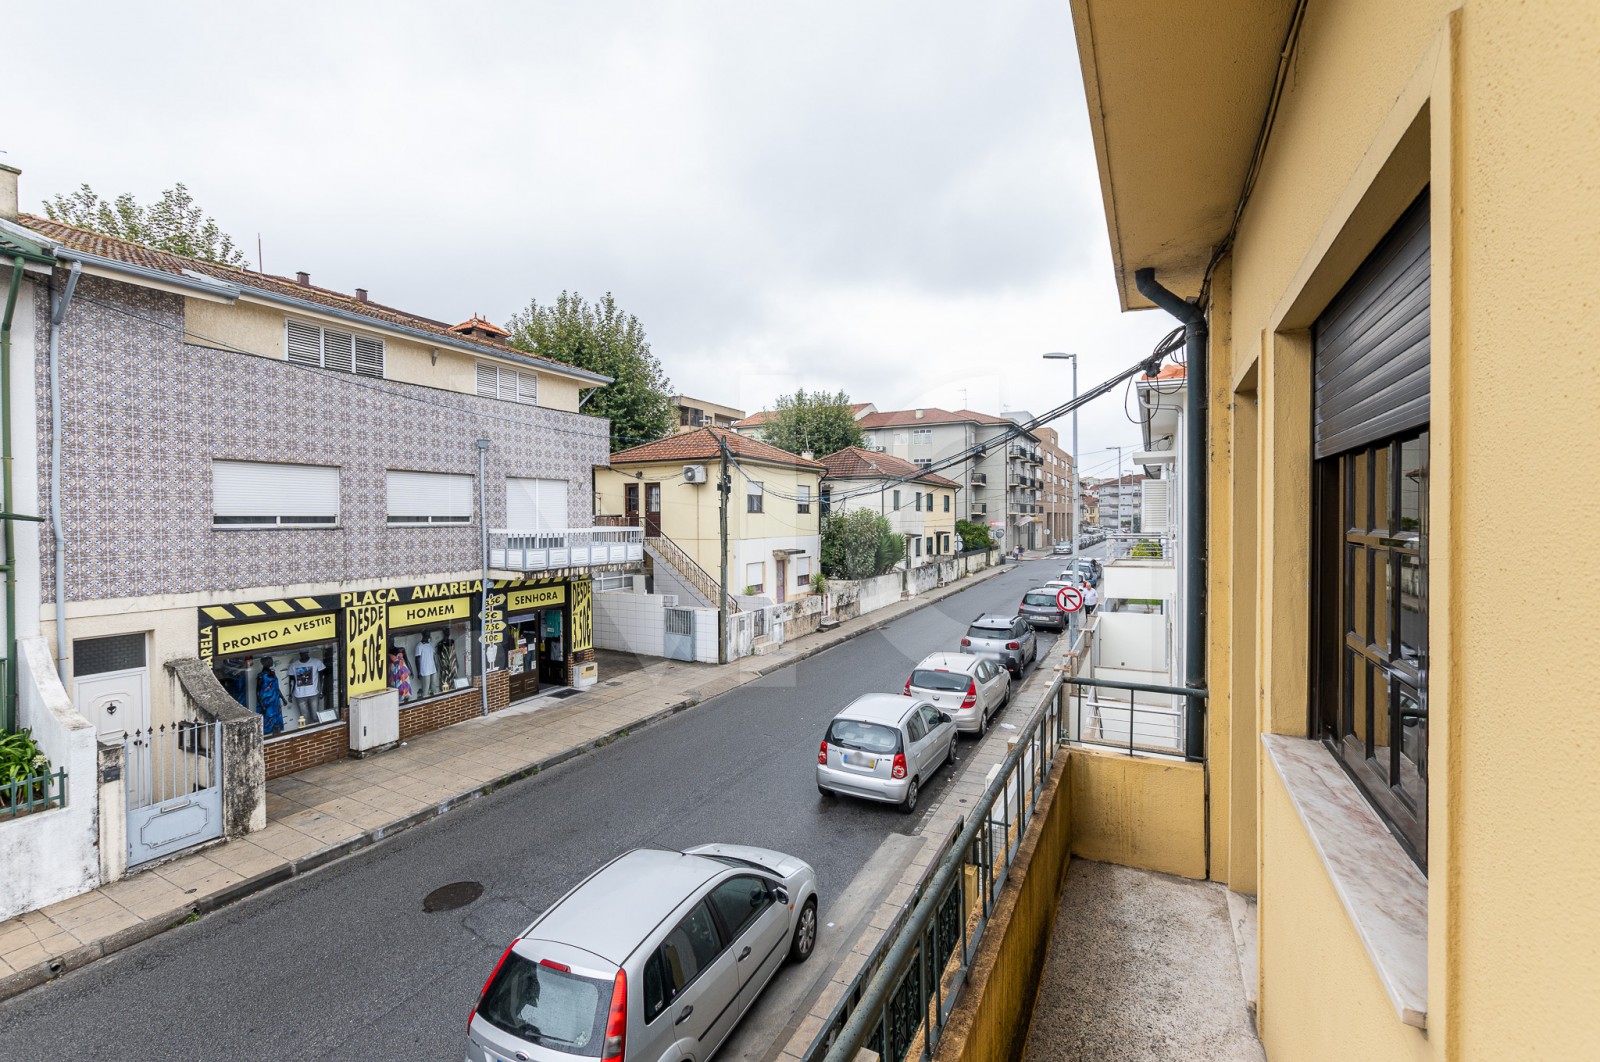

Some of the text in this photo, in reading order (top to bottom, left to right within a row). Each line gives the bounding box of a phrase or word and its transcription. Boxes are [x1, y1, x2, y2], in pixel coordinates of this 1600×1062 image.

[341, 580, 483, 608] PLACA AMARELA
[514, 591, 558, 605] SENHORA
[573, 581, 591, 612] DESDE
[349, 605, 384, 643] DESDE
[406, 604, 455, 620] HOMEM
[200, 625, 213, 669] ARELA
[222, 616, 332, 651] PRONTO A VESTIR
[484, 634, 498, 642] 10€
[349, 623, 384, 686] 3.50€
